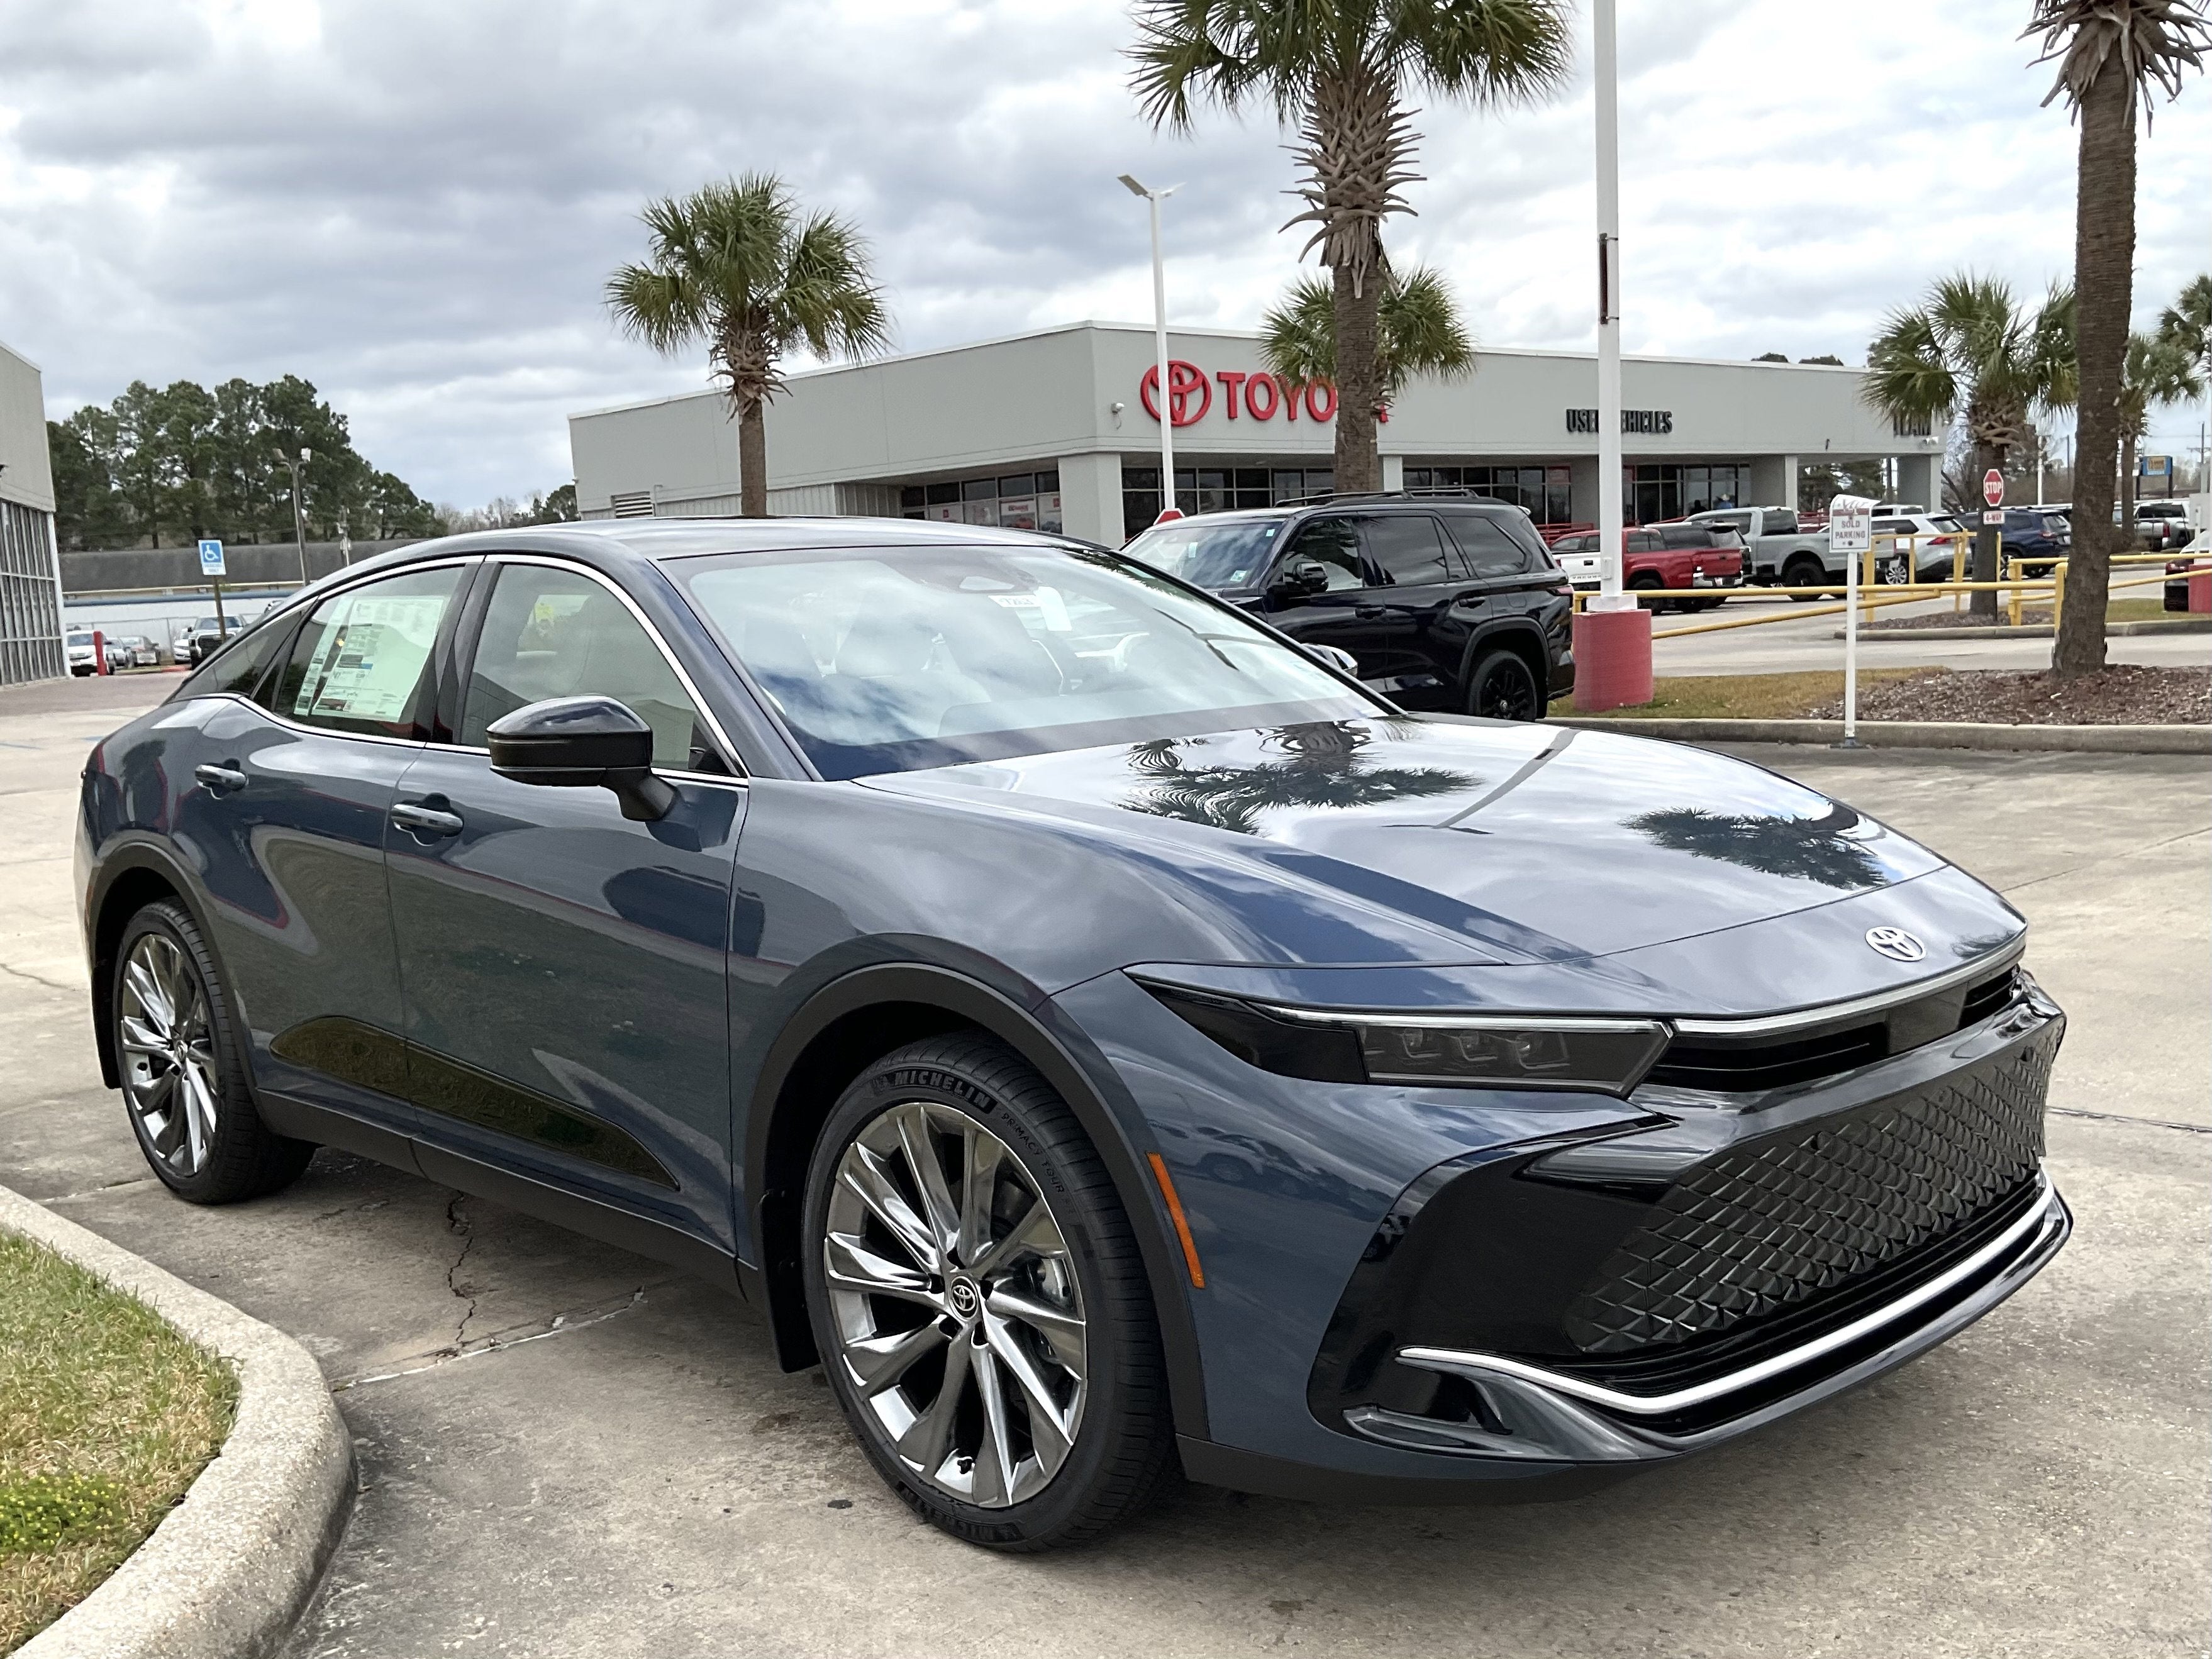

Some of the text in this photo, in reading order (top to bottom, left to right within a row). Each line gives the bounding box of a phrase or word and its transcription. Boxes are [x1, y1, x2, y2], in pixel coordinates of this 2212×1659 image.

[1217, 372, 1389, 423] TOYO
[1566, 409, 1672, 434] USE EHICLES
[1986, 482, 2002, 494] STOP
[1835, 531, 1865, 539] PARKING
[1842, 520, 1860, 528] SOLD
[894, 1070, 991, 1109] MICHELIN
[1001, 1112, 1043, 1156] PRIMACY
